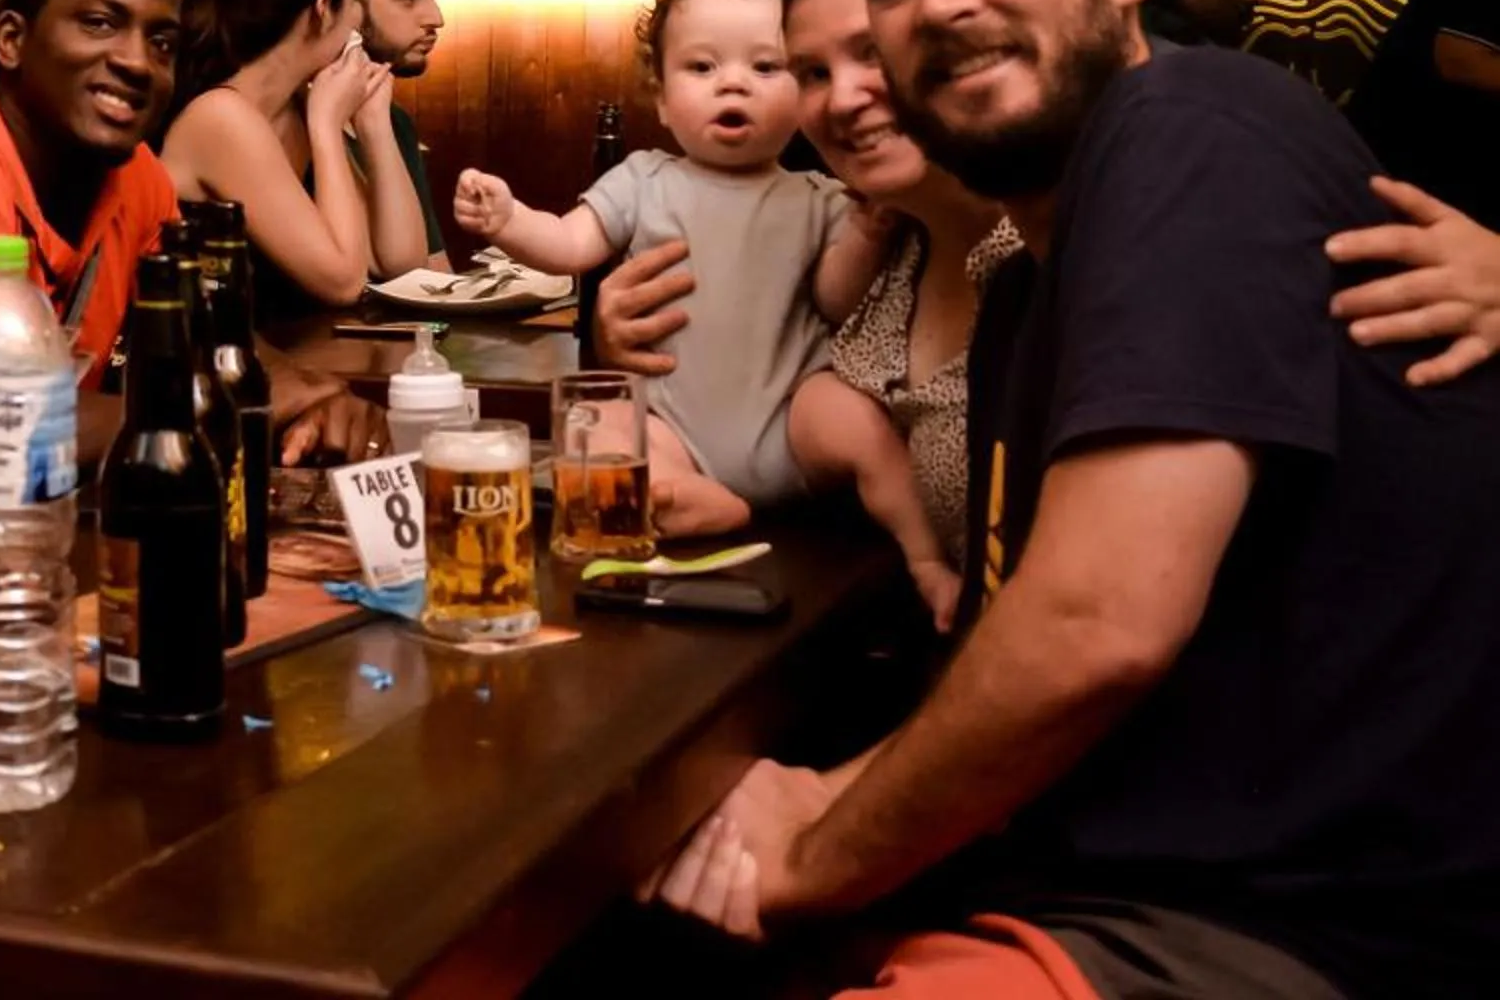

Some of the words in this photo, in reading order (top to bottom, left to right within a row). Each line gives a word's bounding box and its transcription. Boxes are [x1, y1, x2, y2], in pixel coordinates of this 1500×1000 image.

[351, 466, 409, 497] TABLE
[452, 485, 519, 513] LION
[385, 493, 420, 549] 8
